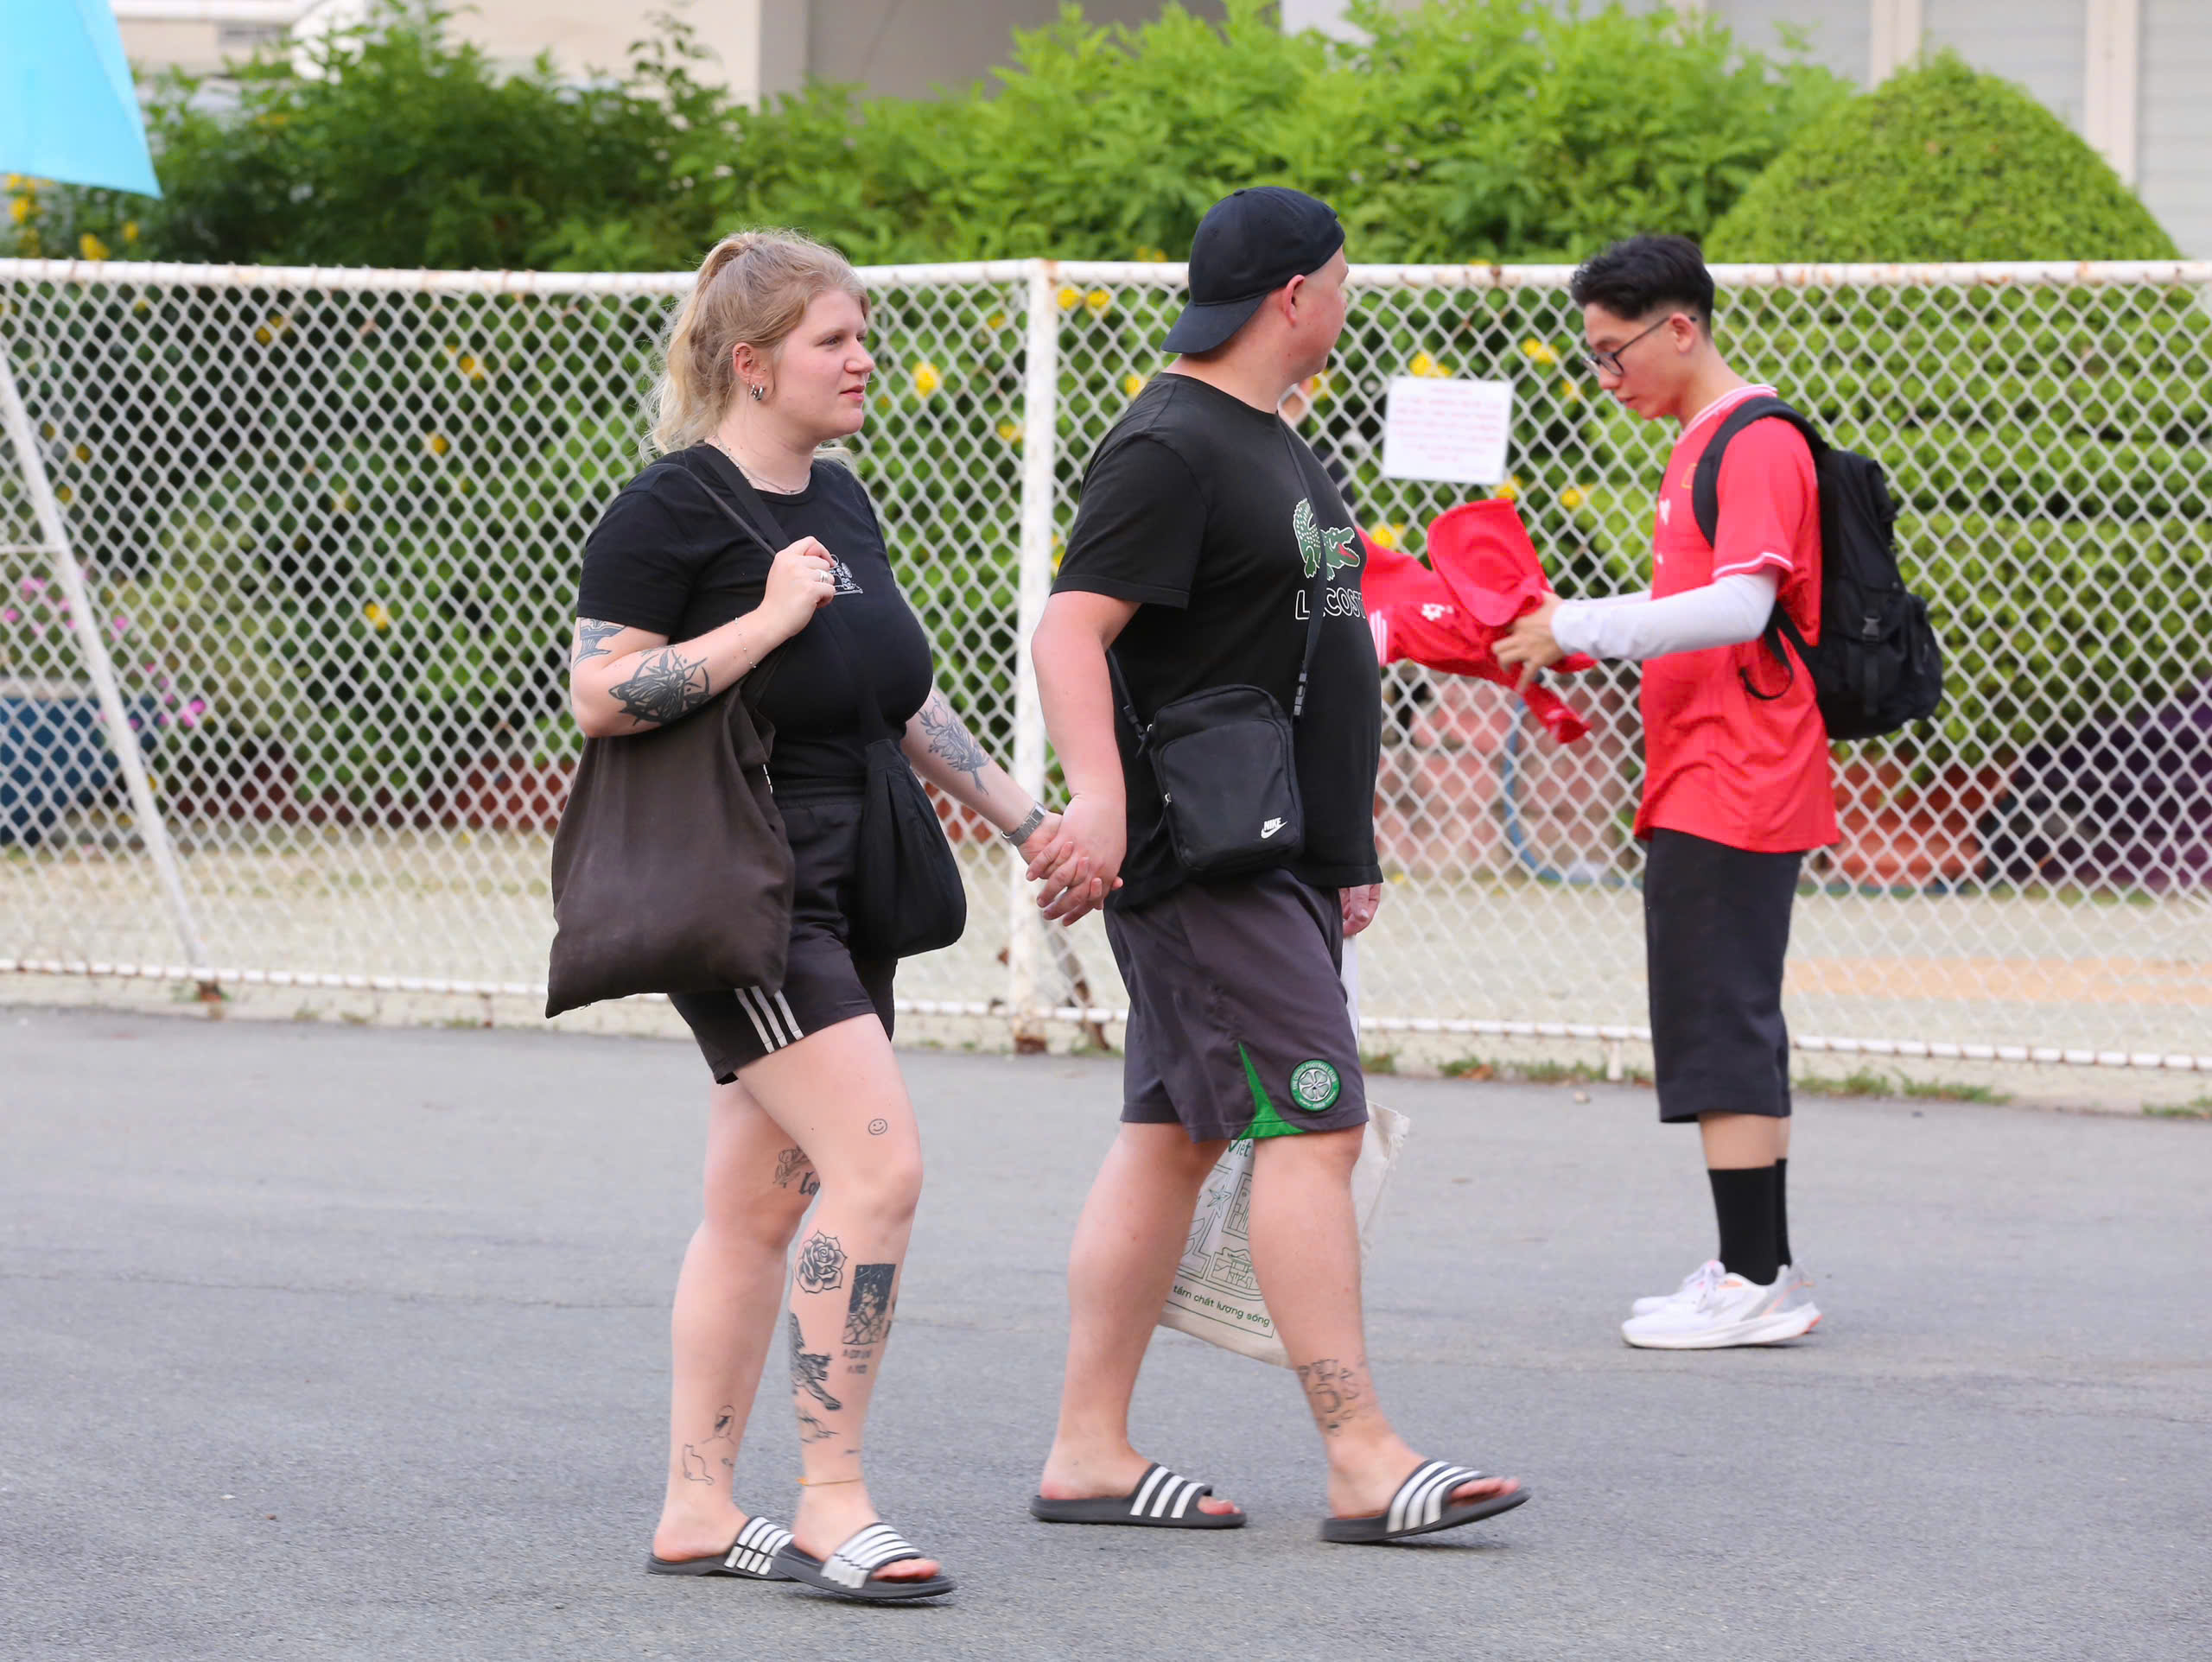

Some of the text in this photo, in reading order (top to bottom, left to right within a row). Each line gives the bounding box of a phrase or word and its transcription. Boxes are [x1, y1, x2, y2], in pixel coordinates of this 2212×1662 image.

[1263, 816, 1282, 831] NIKE
[1216, 1301, 1244, 1320] lượng
[1246, 1313, 1270, 1328] sống
